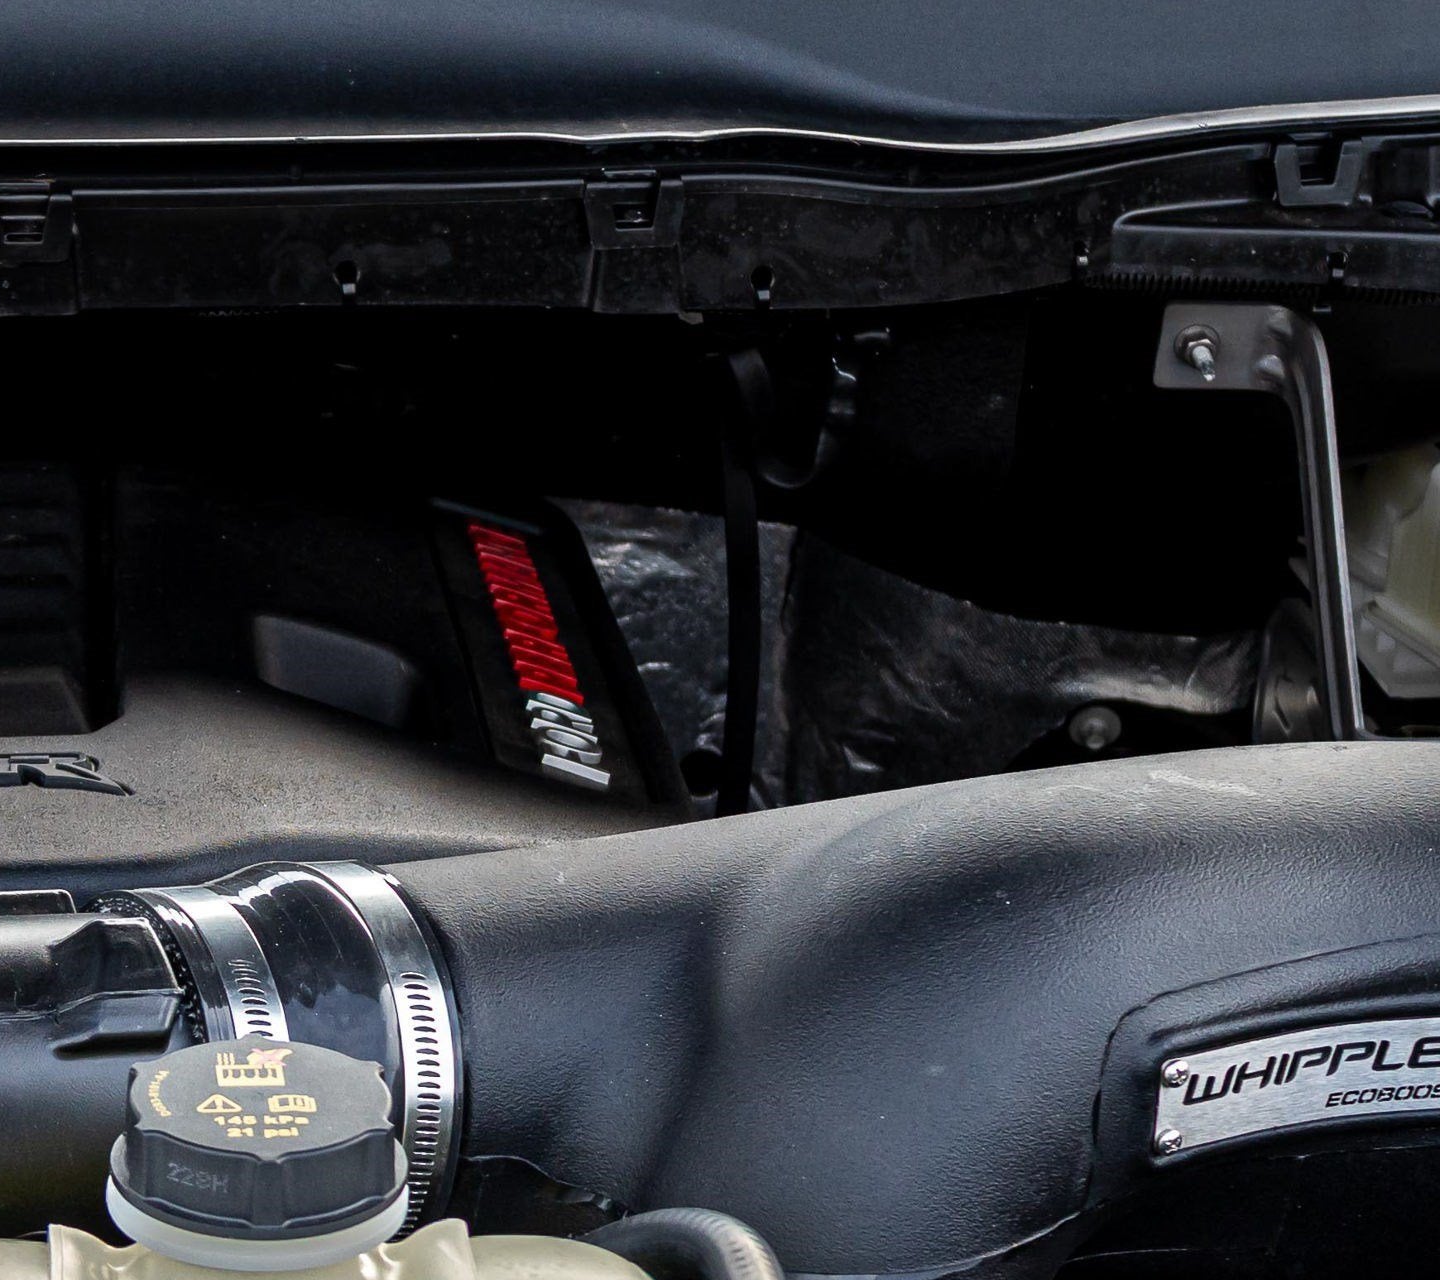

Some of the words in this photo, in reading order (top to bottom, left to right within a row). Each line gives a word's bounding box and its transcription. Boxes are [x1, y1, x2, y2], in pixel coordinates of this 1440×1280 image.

[264, 1115, 309, 1125] kPa
[226, 1128, 249, 1138] 21
[264, 1128, 299, 1138] psi
